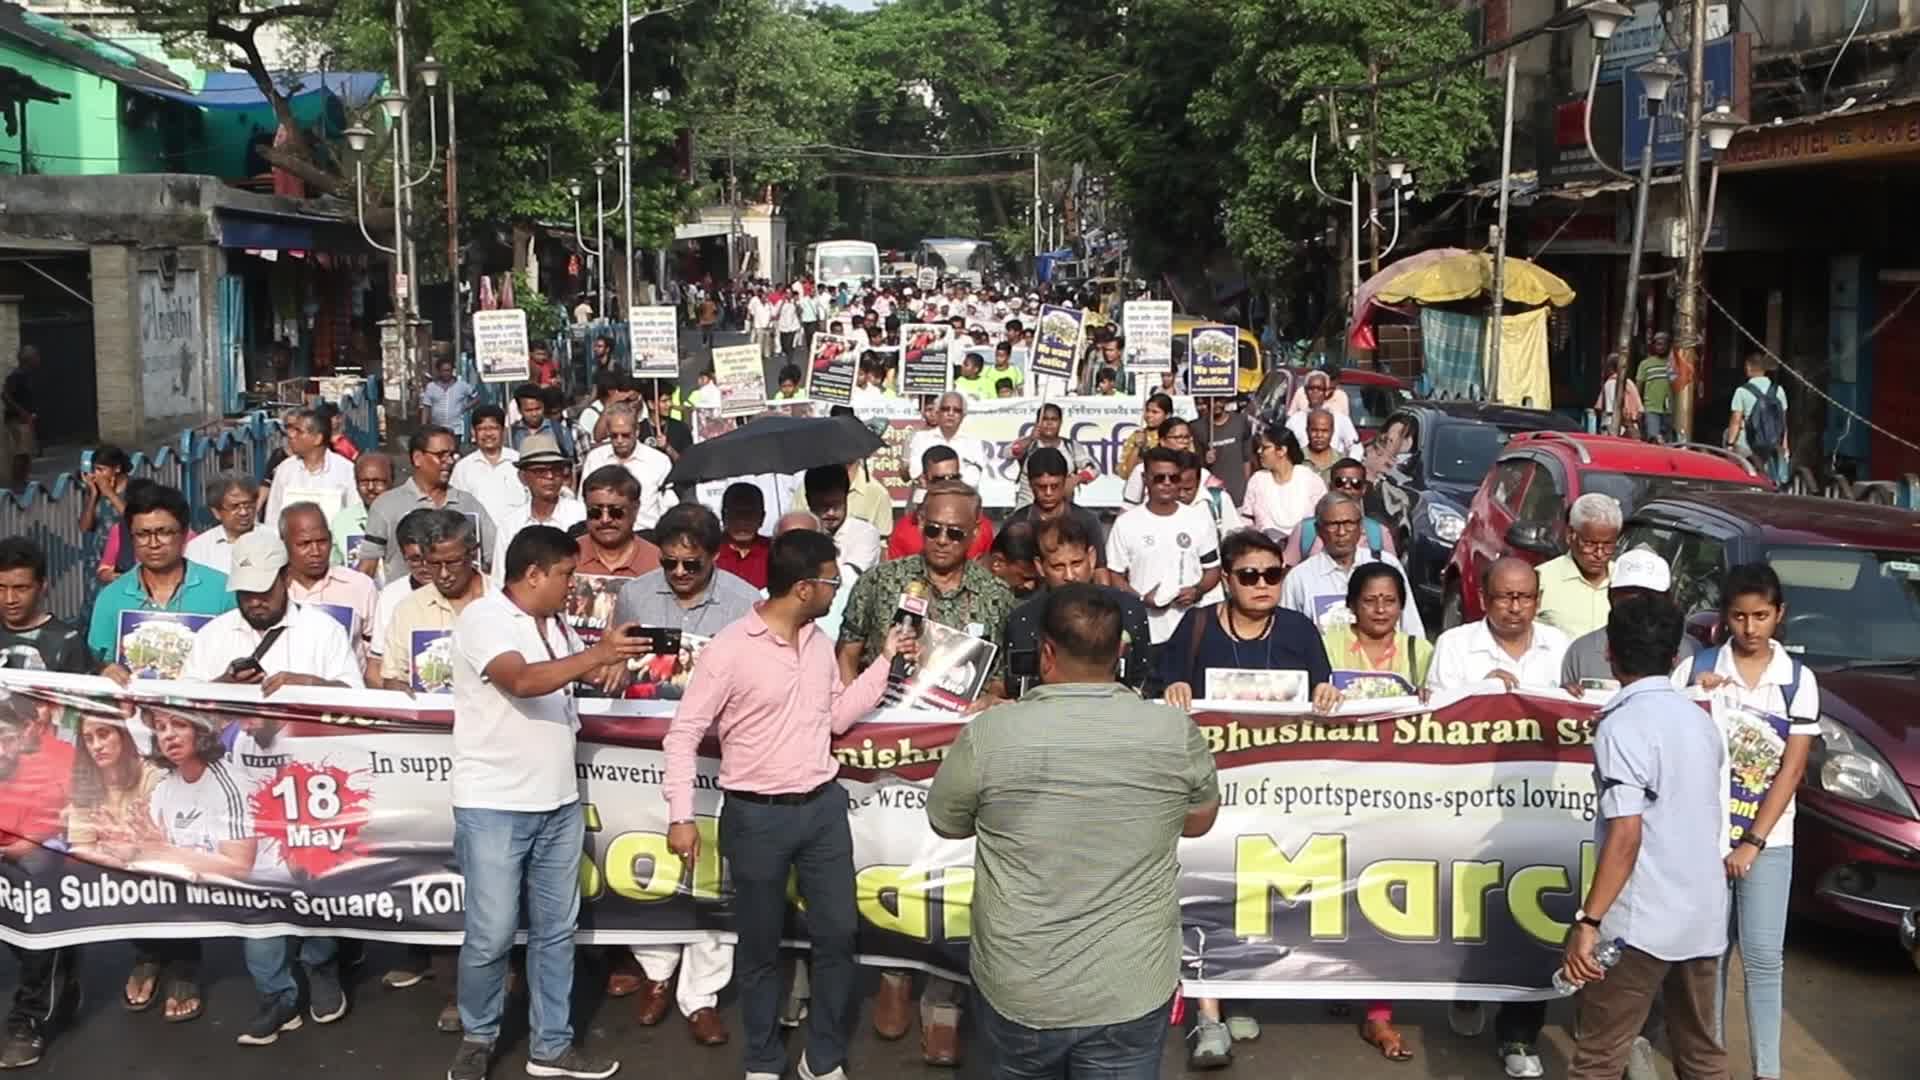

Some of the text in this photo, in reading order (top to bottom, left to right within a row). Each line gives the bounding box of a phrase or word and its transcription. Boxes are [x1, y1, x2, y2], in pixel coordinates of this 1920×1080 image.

[1199, 720, 1379, 753] Bhushan
[1393, 713, 1544, 745] Sharan
[272, 774, 341, 820] 18
[369, 751, 395, 774] In
[400, 756, 453, 781] supp
[576, 763, 665, 785] nwaveri
[878, 789, 926, 809] wres
[1219, 782, 1238, 806] ll
[1245, 778, 1270, 805] of
[1274, 781, 1516, 816] sportspersons-sports
[1523, 778, 1597, 821] loving
[1728, 798, 1759, 820] ant
[287, 824, 346, 851] May
[0, 876, 52, 924] Raja
[290, 889, 403, 923] Square,
